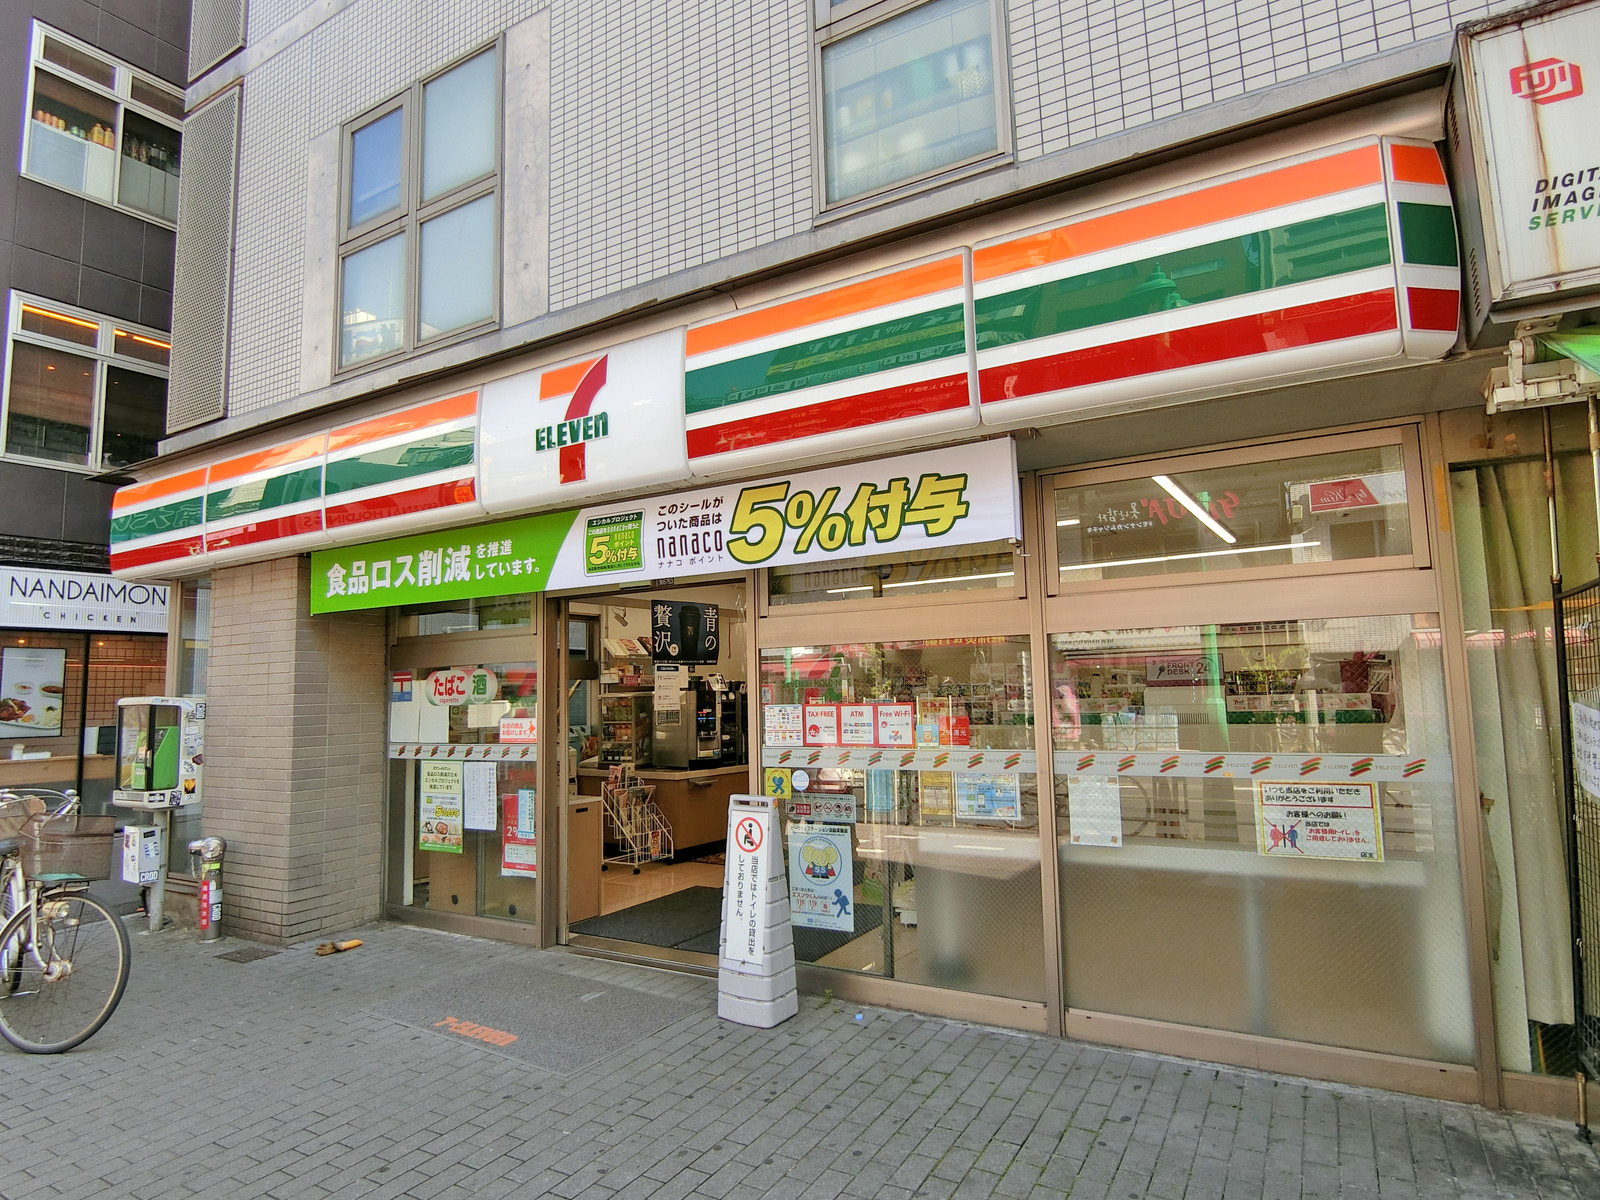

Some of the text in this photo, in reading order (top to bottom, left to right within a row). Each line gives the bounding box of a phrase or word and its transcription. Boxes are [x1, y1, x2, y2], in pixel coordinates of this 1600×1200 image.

[1534, 166, 1600, 194] DIGIT
[1532, 186, 1600, 212] IMAG
[657, 495, 724, 516] このシールが
[591, 513, 638, 526] エシカルプロジェクト
[656, 512, 722, 532] ついた商品は
[726, 473, 970, 564] 5%付与
[475, 539, 513, 559] を推進
[589, 535, 639, 566] 5%付与
[613, 539, 635, 548] ポイント
[656, 530, 723, 559] nanaco
[326, 545, 472, 598] 食品ロス削減
[475, 557, 541, 580] しています。
[657, 554, 724, 569] ナナコ ポイント
[10, 576, 167, 606] NANDAIMON
[703, 607, 718, 651] 青の
[433, 675, 466, 697] たばこ
[472, 674, 488, 696] 酒
[850, 710, 864, 718] ATM
[879, 709, 911, 718] Free Wi-Fi
[1264, 786, 1362, 795] いつも当店をご利用いただき
[1264, 794, 1334, 803] ありがとうございます
[1286, 810, 1347, 819] お客様へのお願い
[814, 866, 827, 874] SS
[735, 854, 745, 921] しておりません。
[747, 855, 759, 956] 当店ではトイレの貸出を
